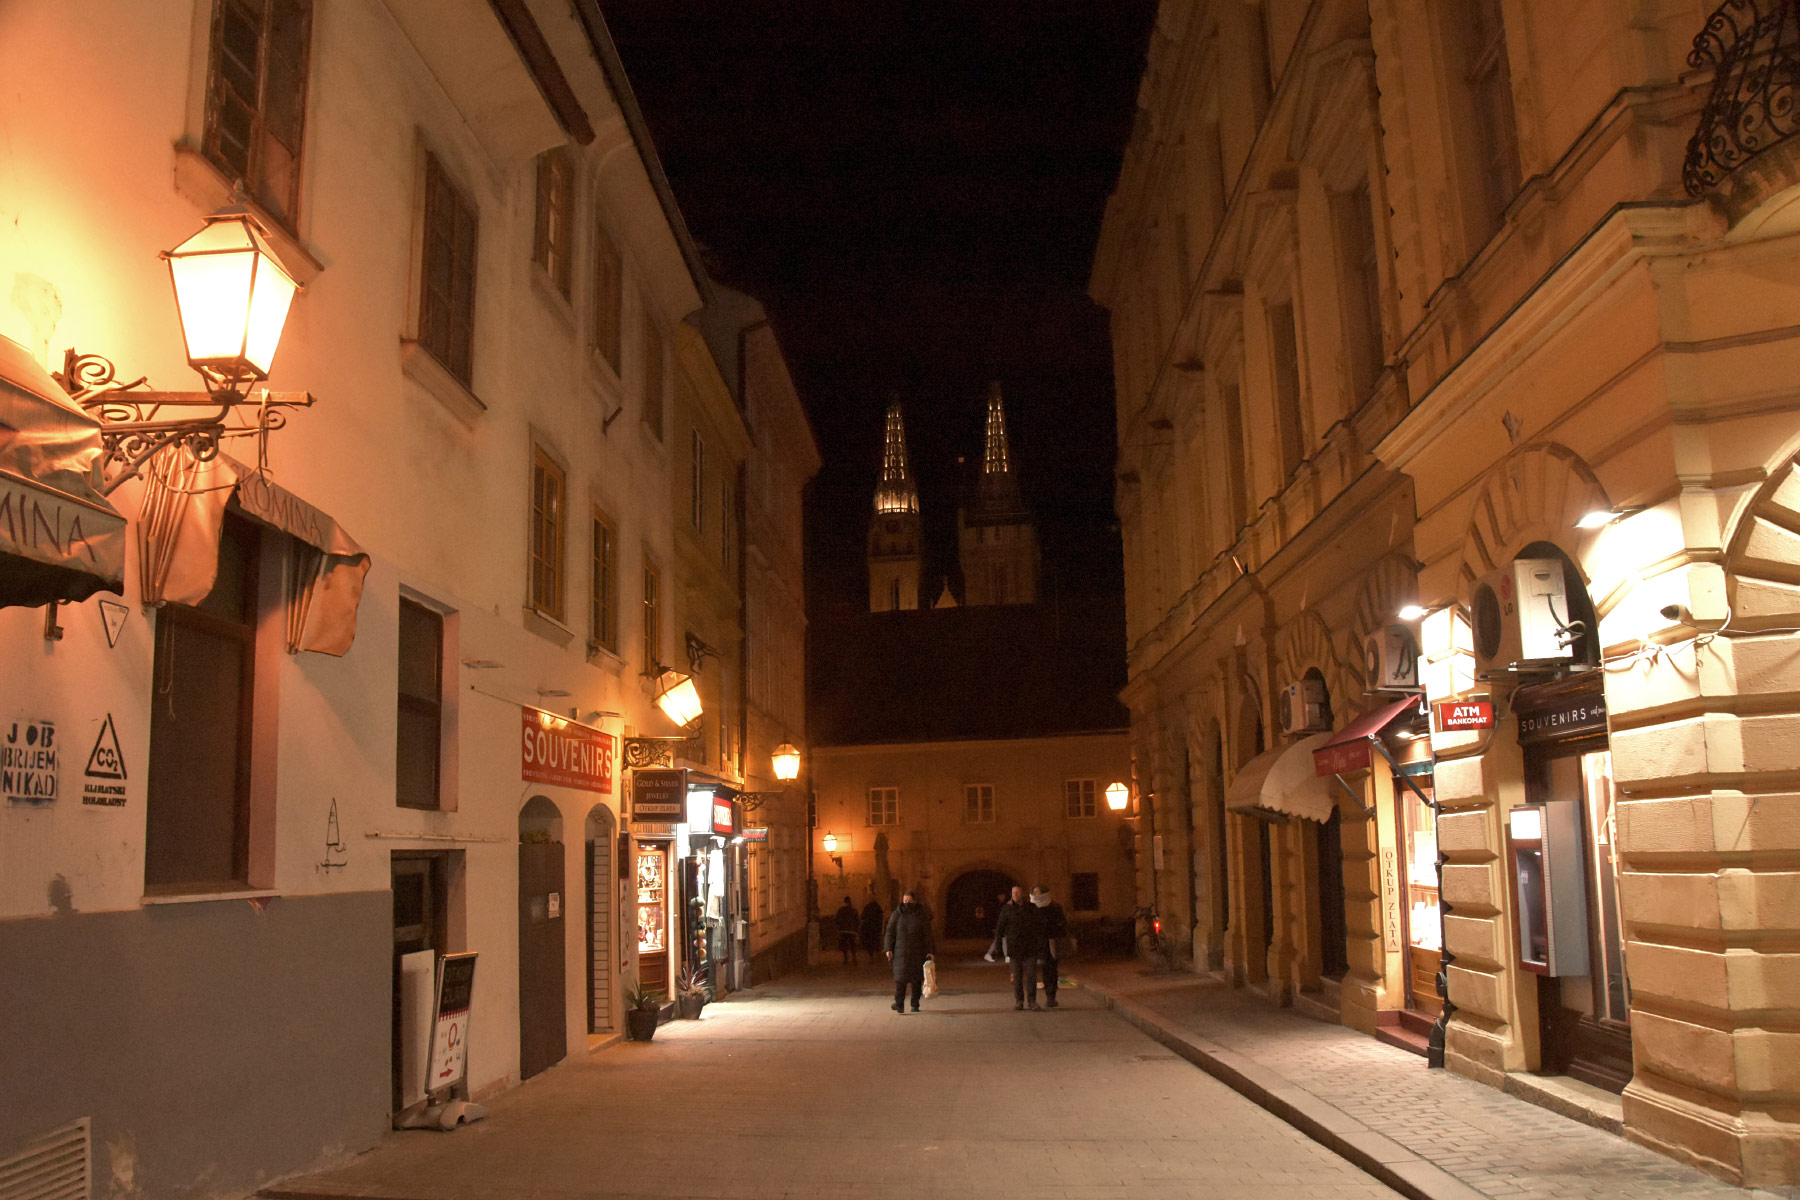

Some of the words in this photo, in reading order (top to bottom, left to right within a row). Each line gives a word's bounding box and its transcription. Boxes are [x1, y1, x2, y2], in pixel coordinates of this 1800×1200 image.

[1447, 717, 1487, 725] BANKOMAT
[1453, 706, 1480, 718] ATM
[1521, 707, 1587, 732] SOUVENIRS
[3, 746, 56, 771] BRIJEM
[524, 726, 612, 779] SOUVENIRS
[3, 769, 56, 797] NIKAD
[1385, 851, 1394, 896] OTKUP
[1388, 902, 1397, 948] ZLATA
